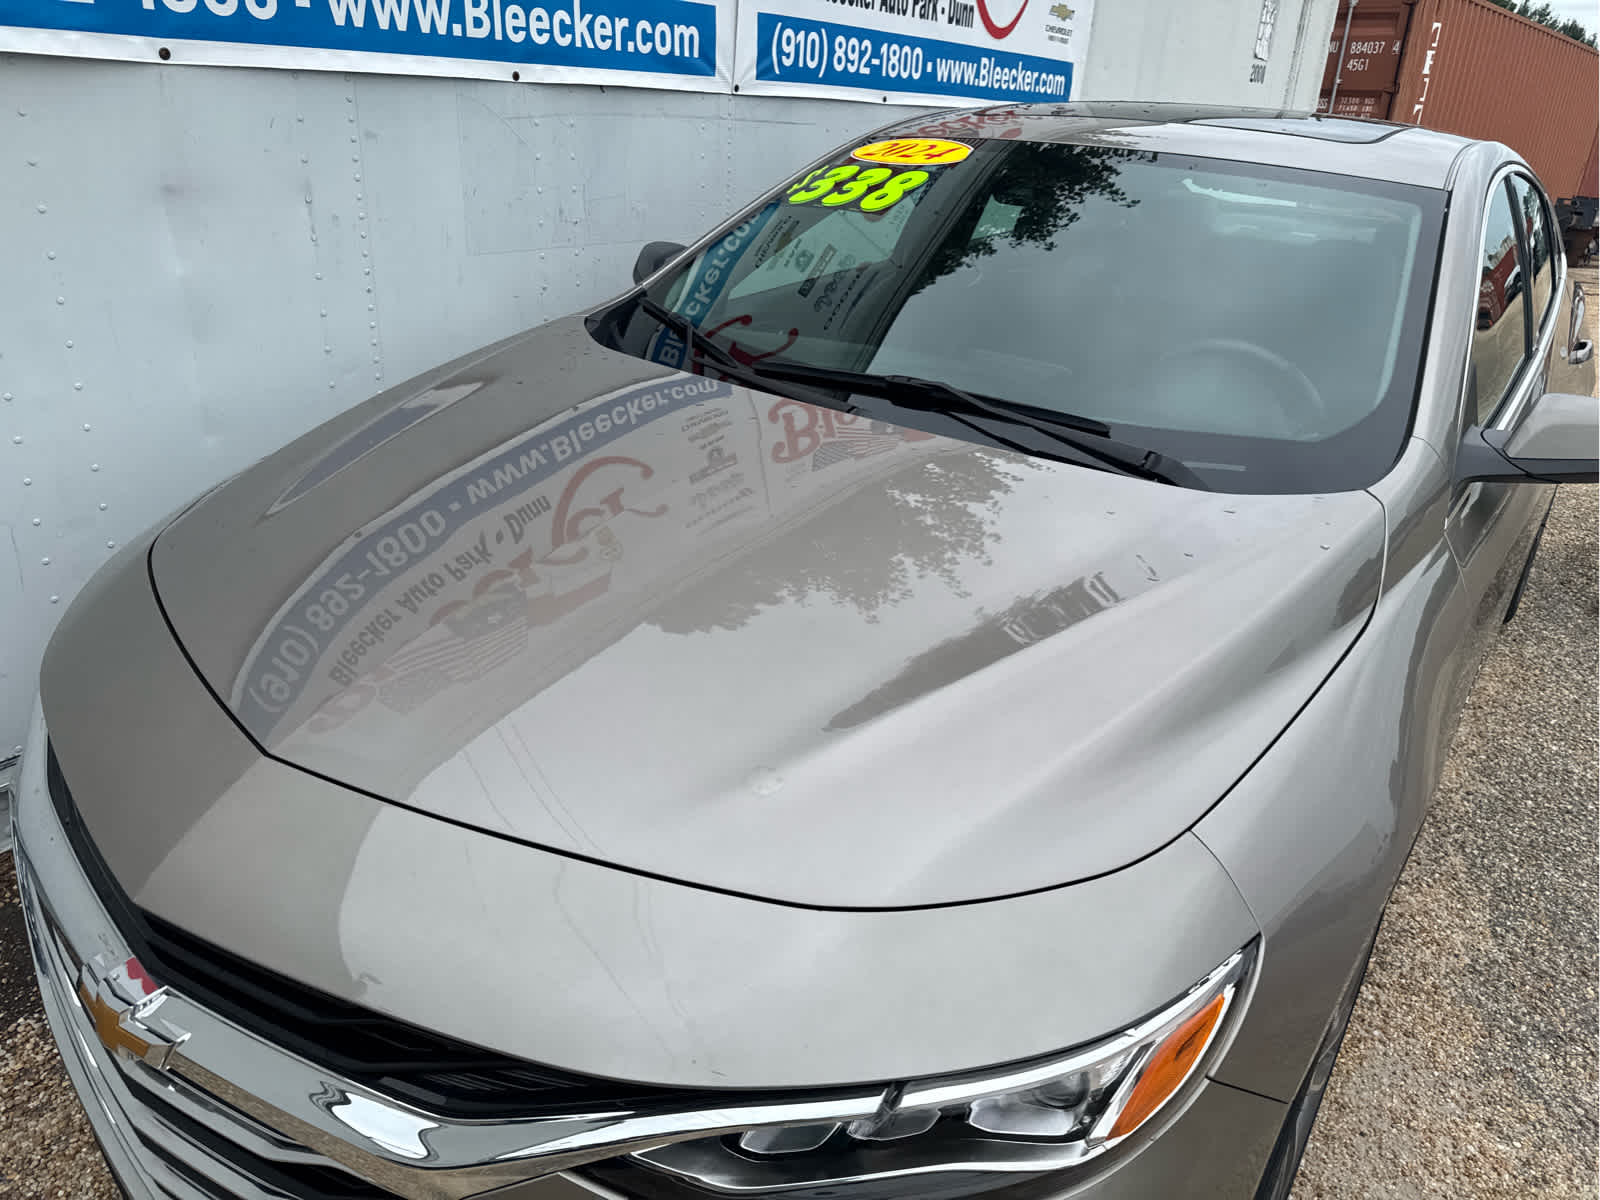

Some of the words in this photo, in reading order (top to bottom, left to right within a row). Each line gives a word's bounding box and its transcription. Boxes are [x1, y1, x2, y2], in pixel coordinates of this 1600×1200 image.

[947, 0, 975, 29] Dunn
[1350, 41, 1385, 54] 884037
[771, 22, 828, 78] (910)
[833, 35, 924, 80] 892-1800
[936, 57, 1066, 97] www.Bleecker.com
[1346, 58, 1369, 71] 45G1
[861, 143, 963, 160] 2024
